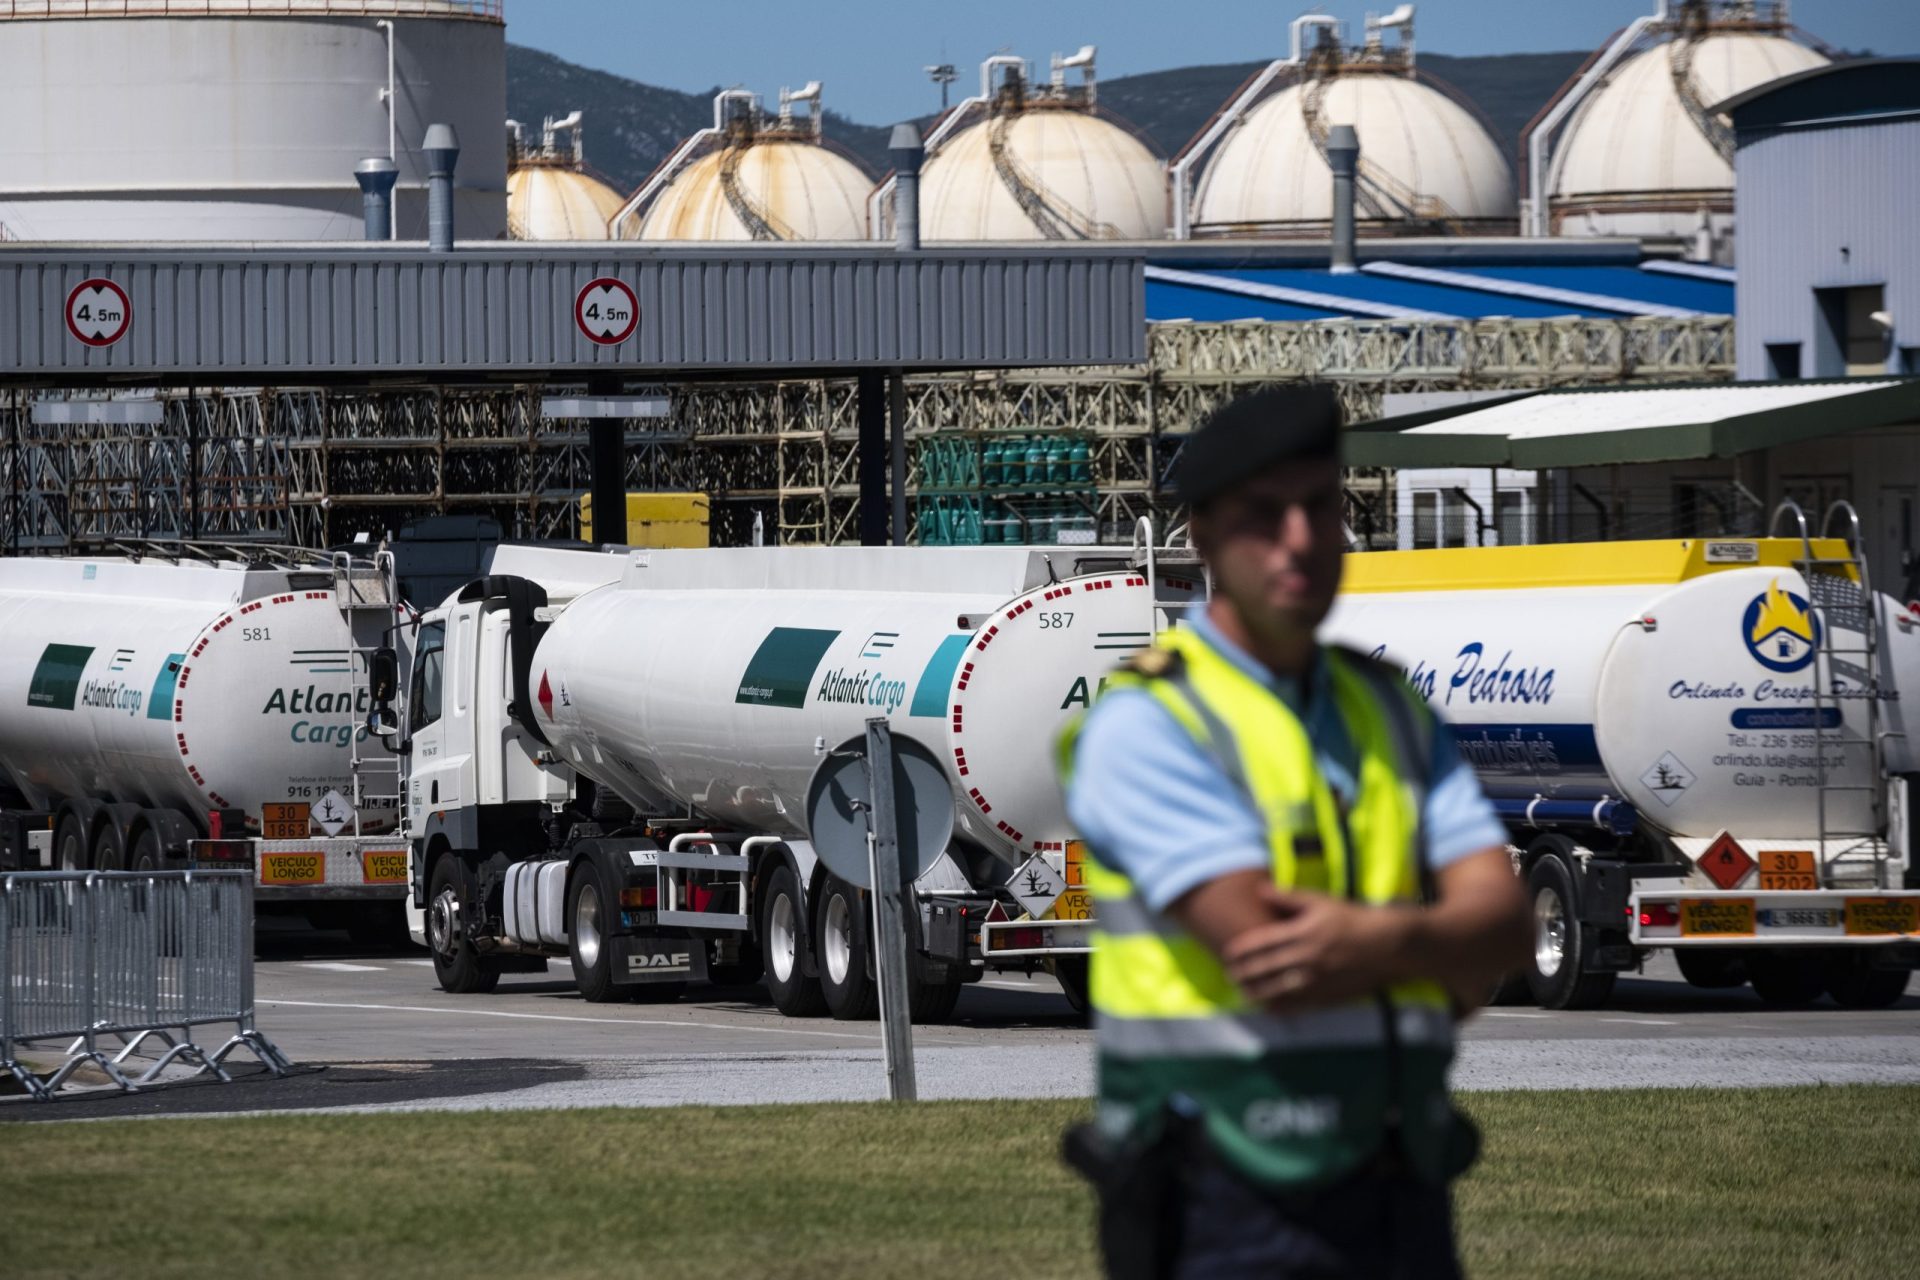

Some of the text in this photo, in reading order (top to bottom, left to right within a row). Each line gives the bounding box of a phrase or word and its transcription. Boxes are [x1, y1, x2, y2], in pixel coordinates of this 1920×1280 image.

[77, 304, 121, 322] 4.5m
[585, 303, 629, 321] 4.5m
[1039, 612, 1074, 629] 587
[242, 627, 271, 641] 581
[1446, 642, 1555, 706] Pedrosa
[817, 667, 906, 715] Atlantic Cargo
[1668, 680, 1746, 700] Orlindo
[82, 680, 142, 716] Atlantic Cargo
[287, 786, 311, 797] 916
[278, 806, 296, 819] 30
[269, 823, 306, 837] 1863
[269, 857, 317, 868] VEICULO
[372, 856, 407, 868] VEICU
[1774, 854, 1799, 870] 30
[272, 868, 316, 879] LONGO
[375, 867, 407, 878] LONG
[1065, 894, 1093, 908] VEIC
[628, 953, 690, 968] DAF
